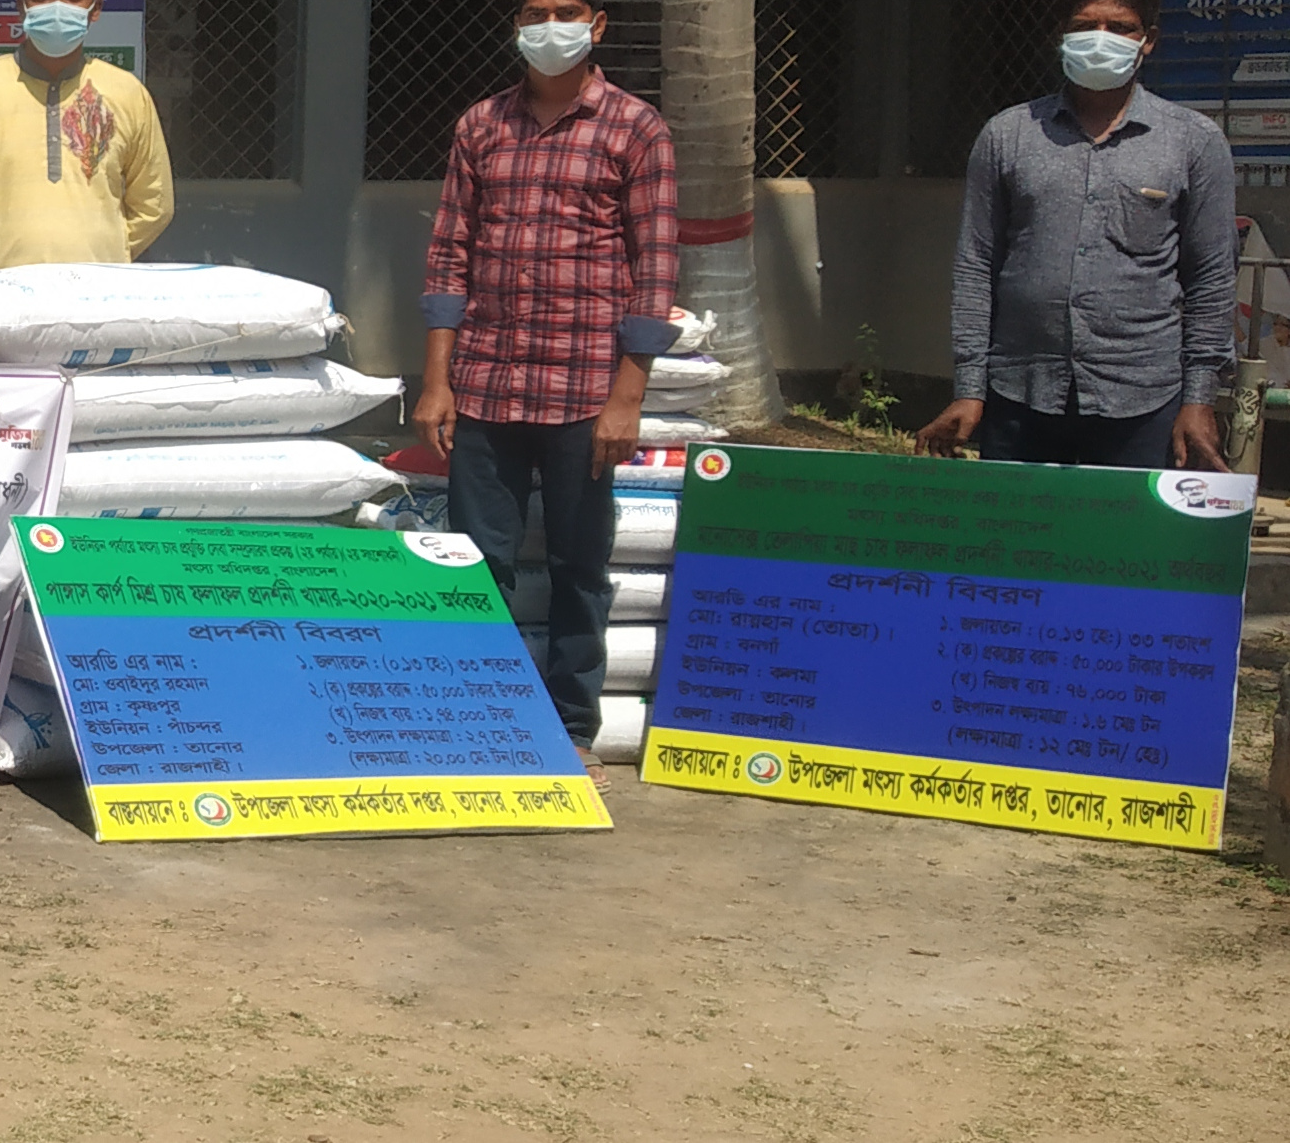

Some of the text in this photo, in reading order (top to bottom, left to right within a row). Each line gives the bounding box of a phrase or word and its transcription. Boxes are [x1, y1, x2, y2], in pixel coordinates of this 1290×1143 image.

[45, 581, 96, 604] পাঙ্গাস
[94, 579, 125, 604] কার্প
[123, 580, 160, 605] মিশ্র
[158, 583, 190, 605] চাষ
[188, 584, 248, 606] ফলাফল
[246, 583, 298, 606] প্রদর্শনী
[787, 750, 858, 793] উপজেলা
[861, 766, 905, 799] মৎস্য
[908, 765, 986, 808] কর্মকর্তার
